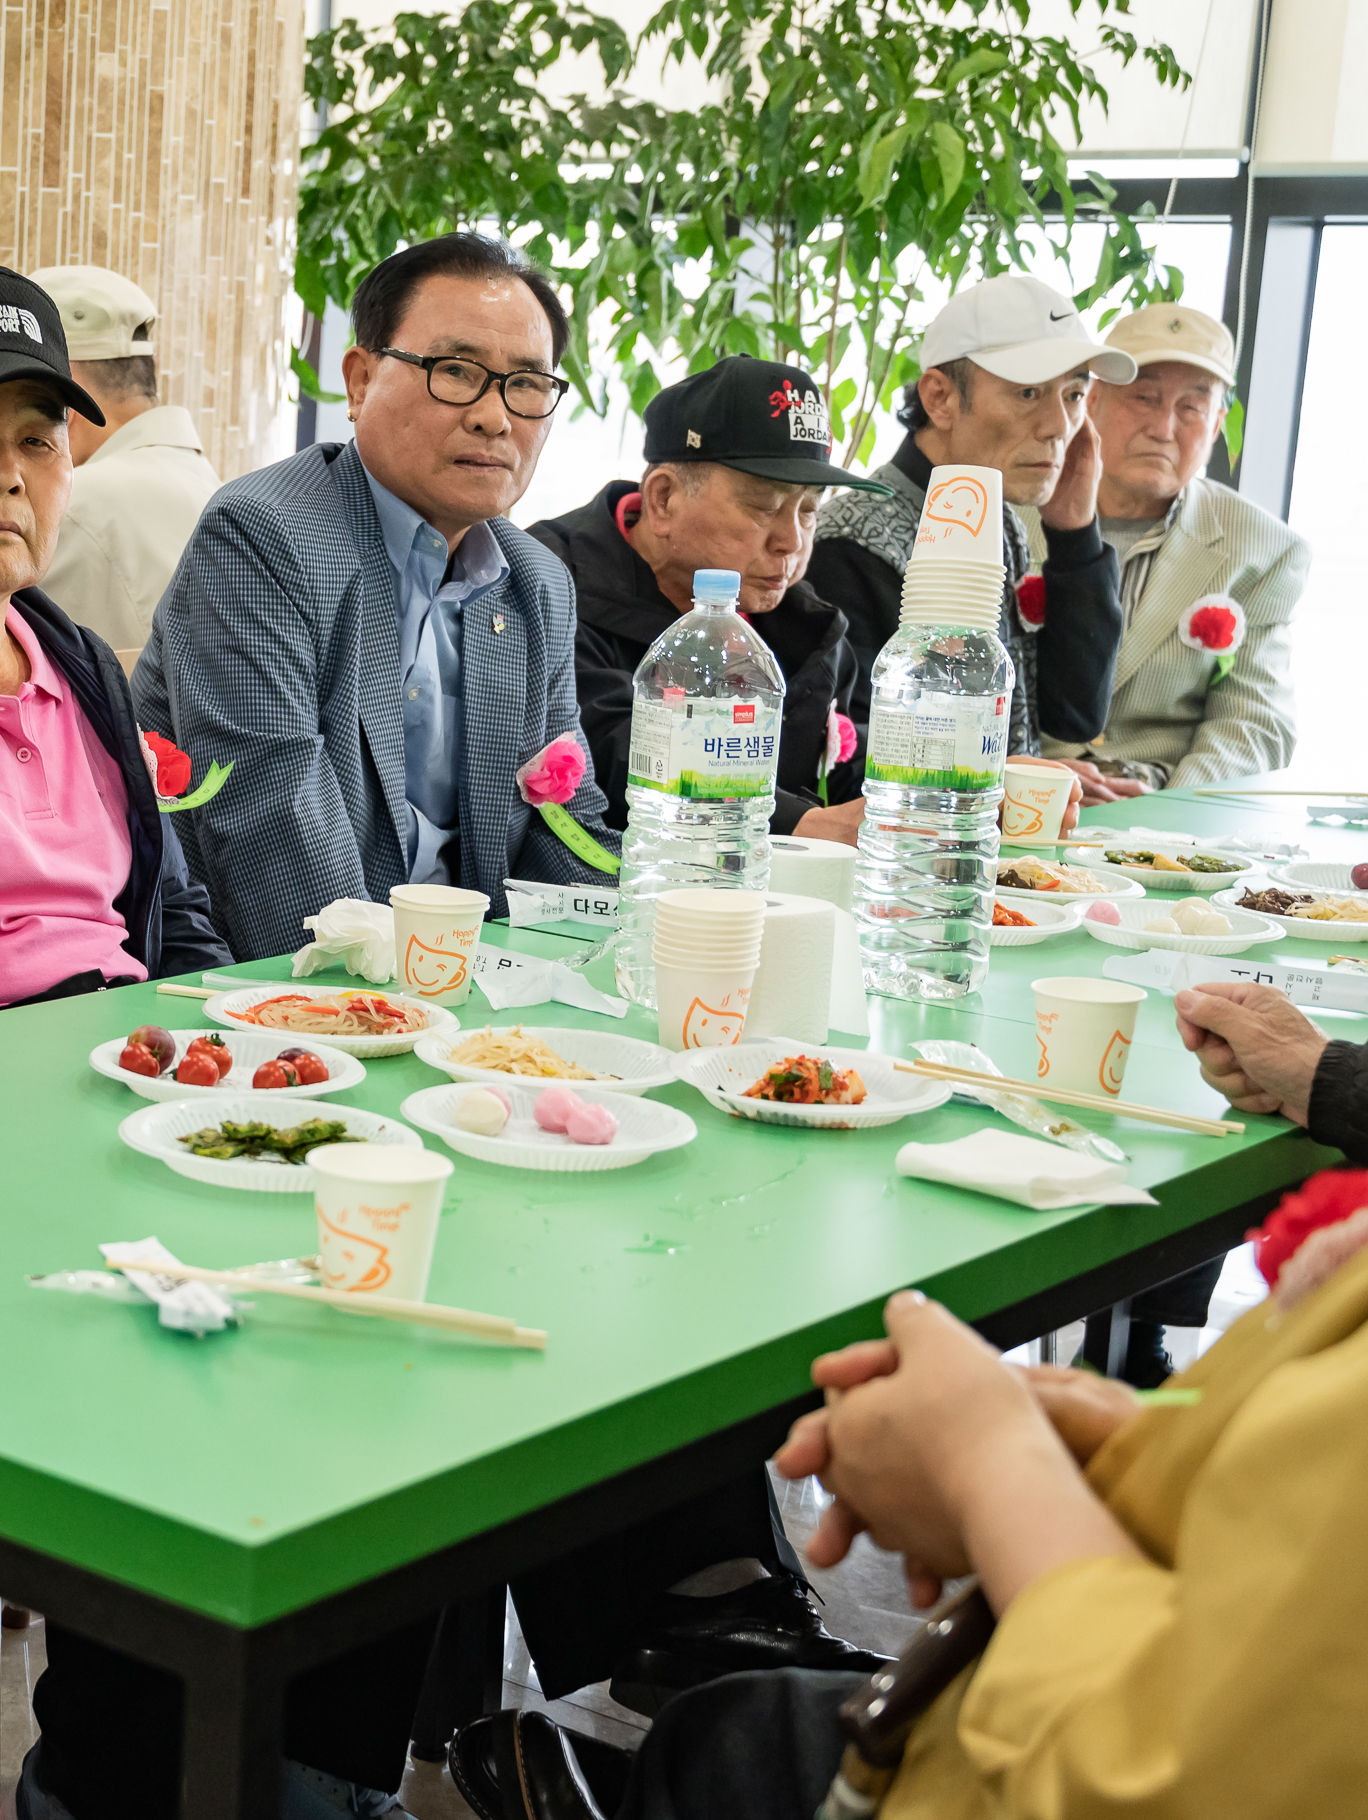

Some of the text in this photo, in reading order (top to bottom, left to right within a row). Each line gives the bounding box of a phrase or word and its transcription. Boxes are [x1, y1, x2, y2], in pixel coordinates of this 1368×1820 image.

[704, 735, 775, 759] 바른샘물
[708, 759, 771, 767] Natural Mineral Water
[451, 924, 480, 940] Happy
[459, 938, 474, 948] Time
